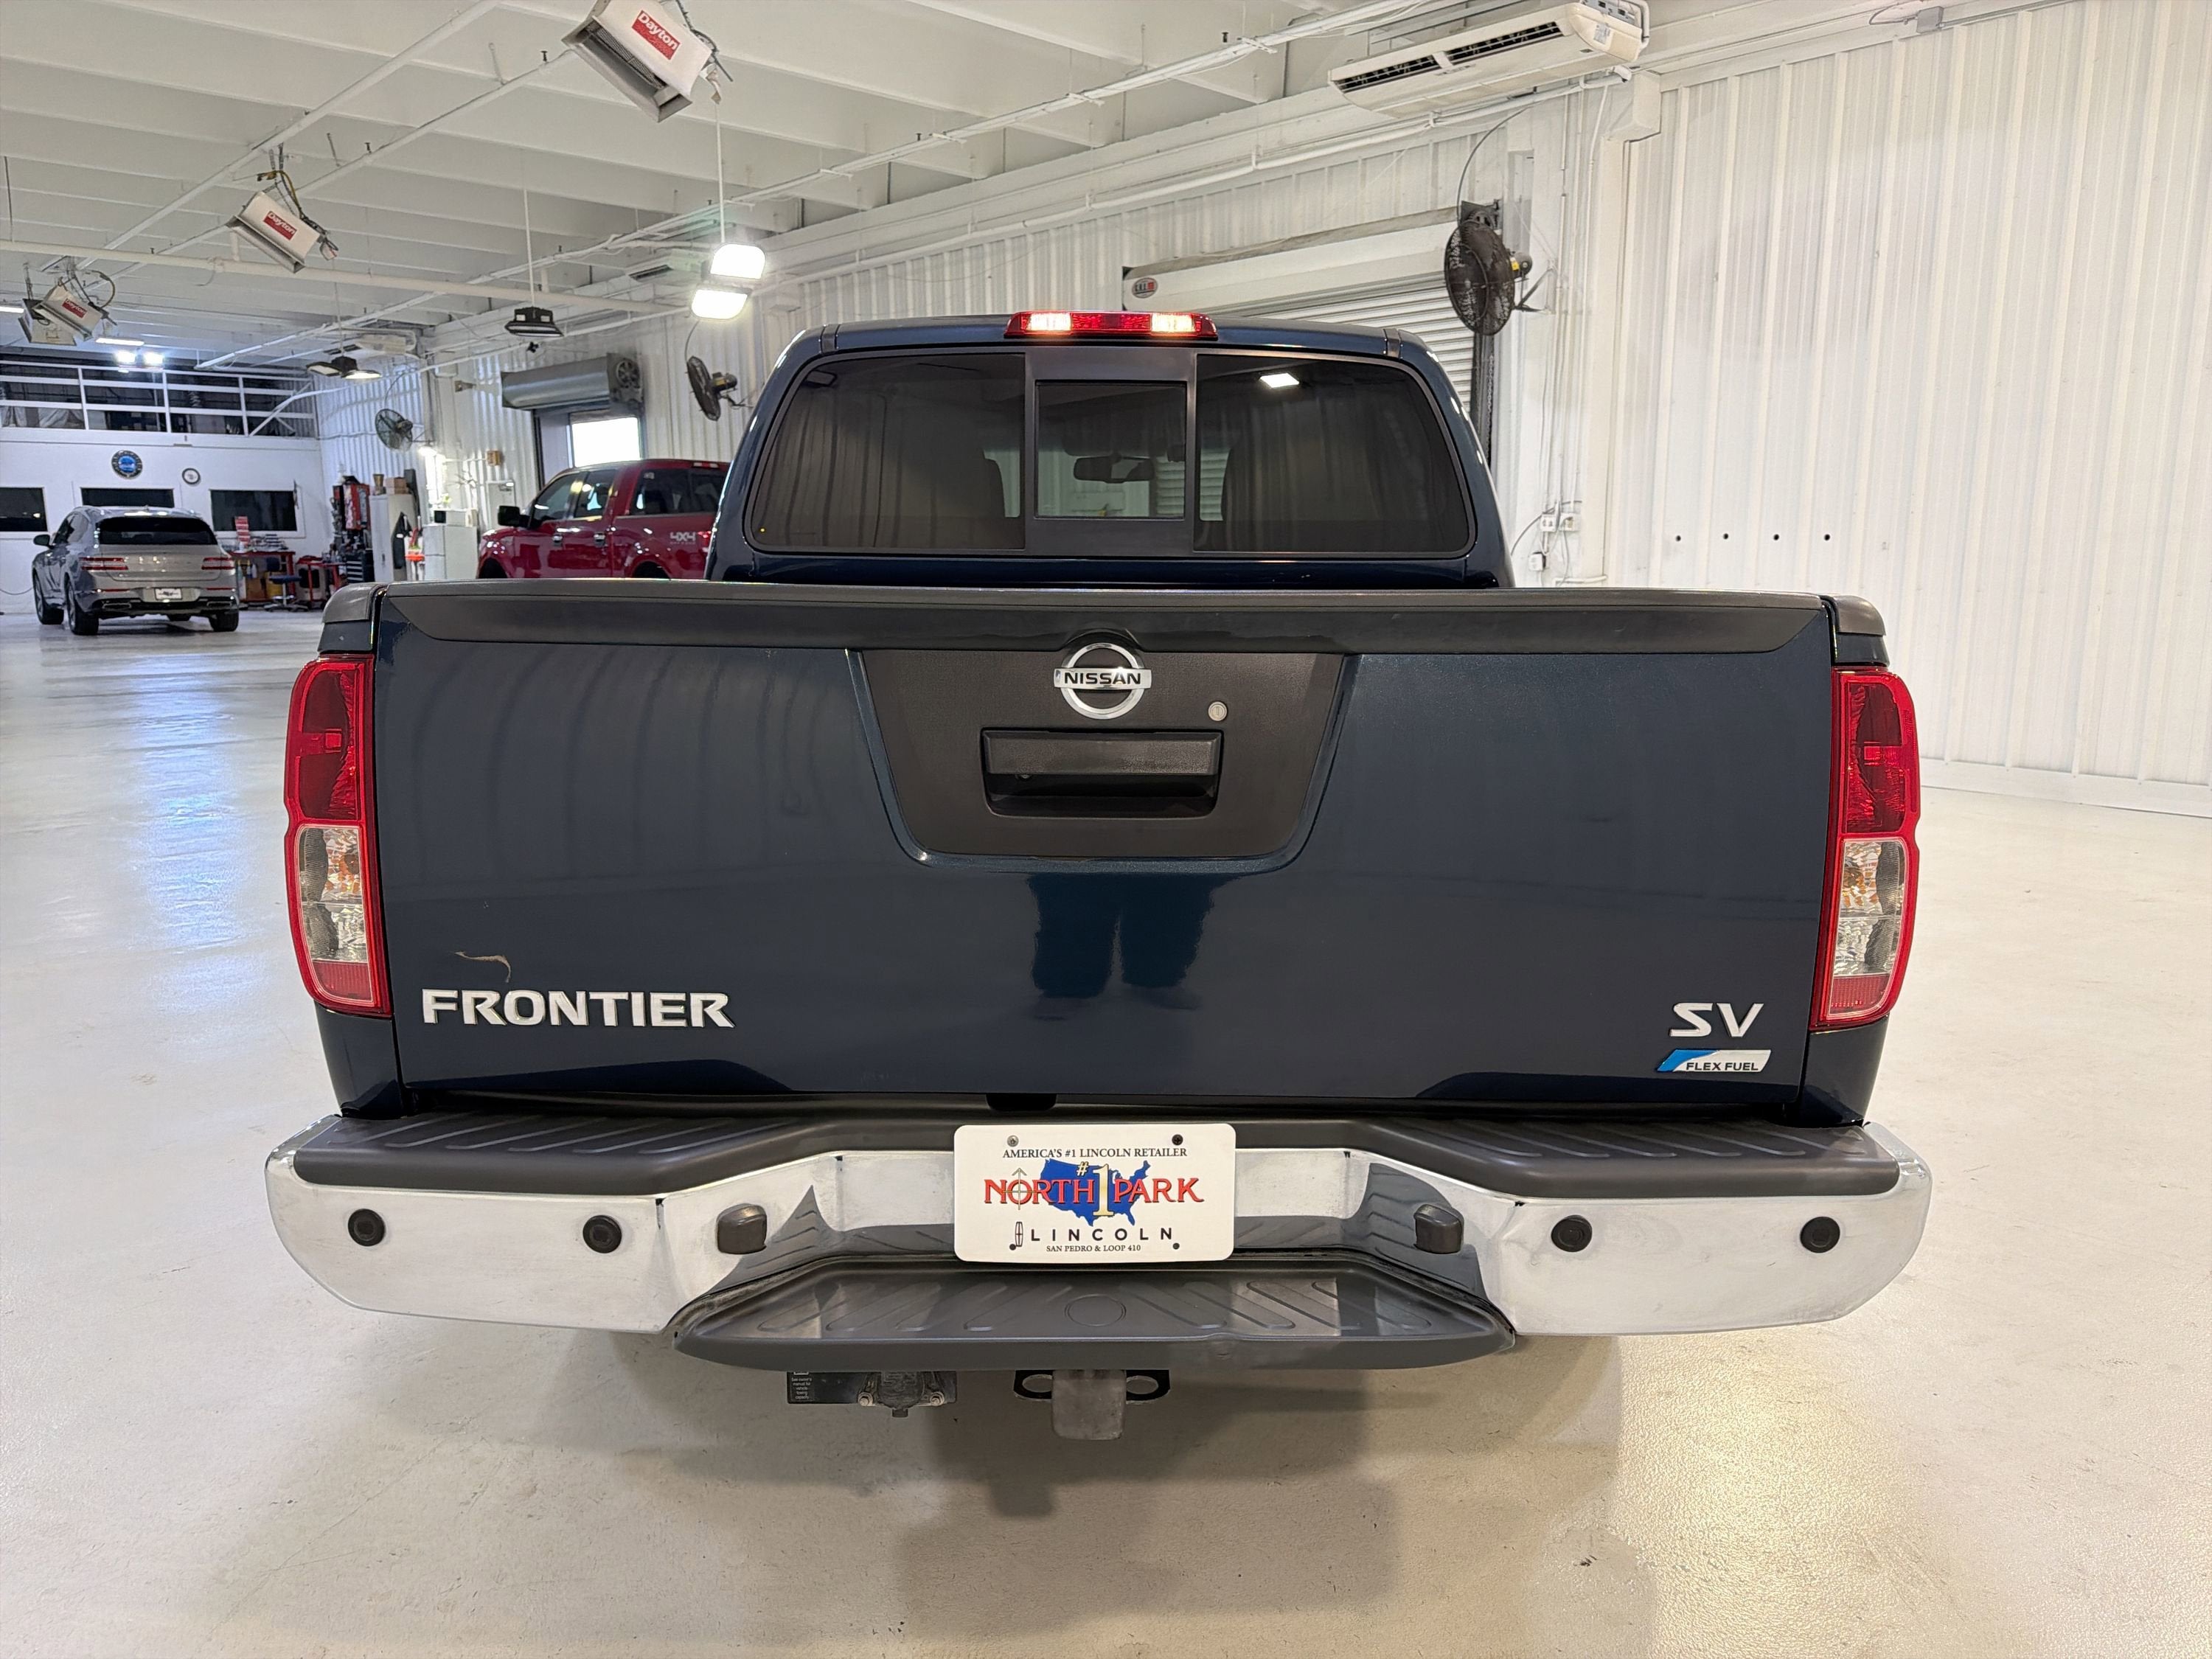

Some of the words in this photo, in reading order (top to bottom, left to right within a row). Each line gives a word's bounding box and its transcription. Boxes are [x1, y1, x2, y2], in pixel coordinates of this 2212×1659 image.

[637, 13, 678, 50] Dayton
[268, 212, 296, 234] Dayton
[1065, 672, 1141, 685] NISSAN
[421, 989, 735, 1028] FRONTIER
[1669, 1003, 1764, 1037] SV
[1686, 1062, 1722, 1071] FLEX
[1725, 1062, 1759, 1071] FUEL
[1003, 1149, 1062, 1158] AMERICA'S
[1065, 1149, 1076, 1157] #1
[1079, 1148, 1131, 1158] LINCOLN
[1134, 1148, 1187, 1157] RETAILER
[984, 1179, 1094, 1205] NORTH
[1113, 1178, 1203, 1203] PARK
[1032, 1228, 1172, 1242] LINCOLN
